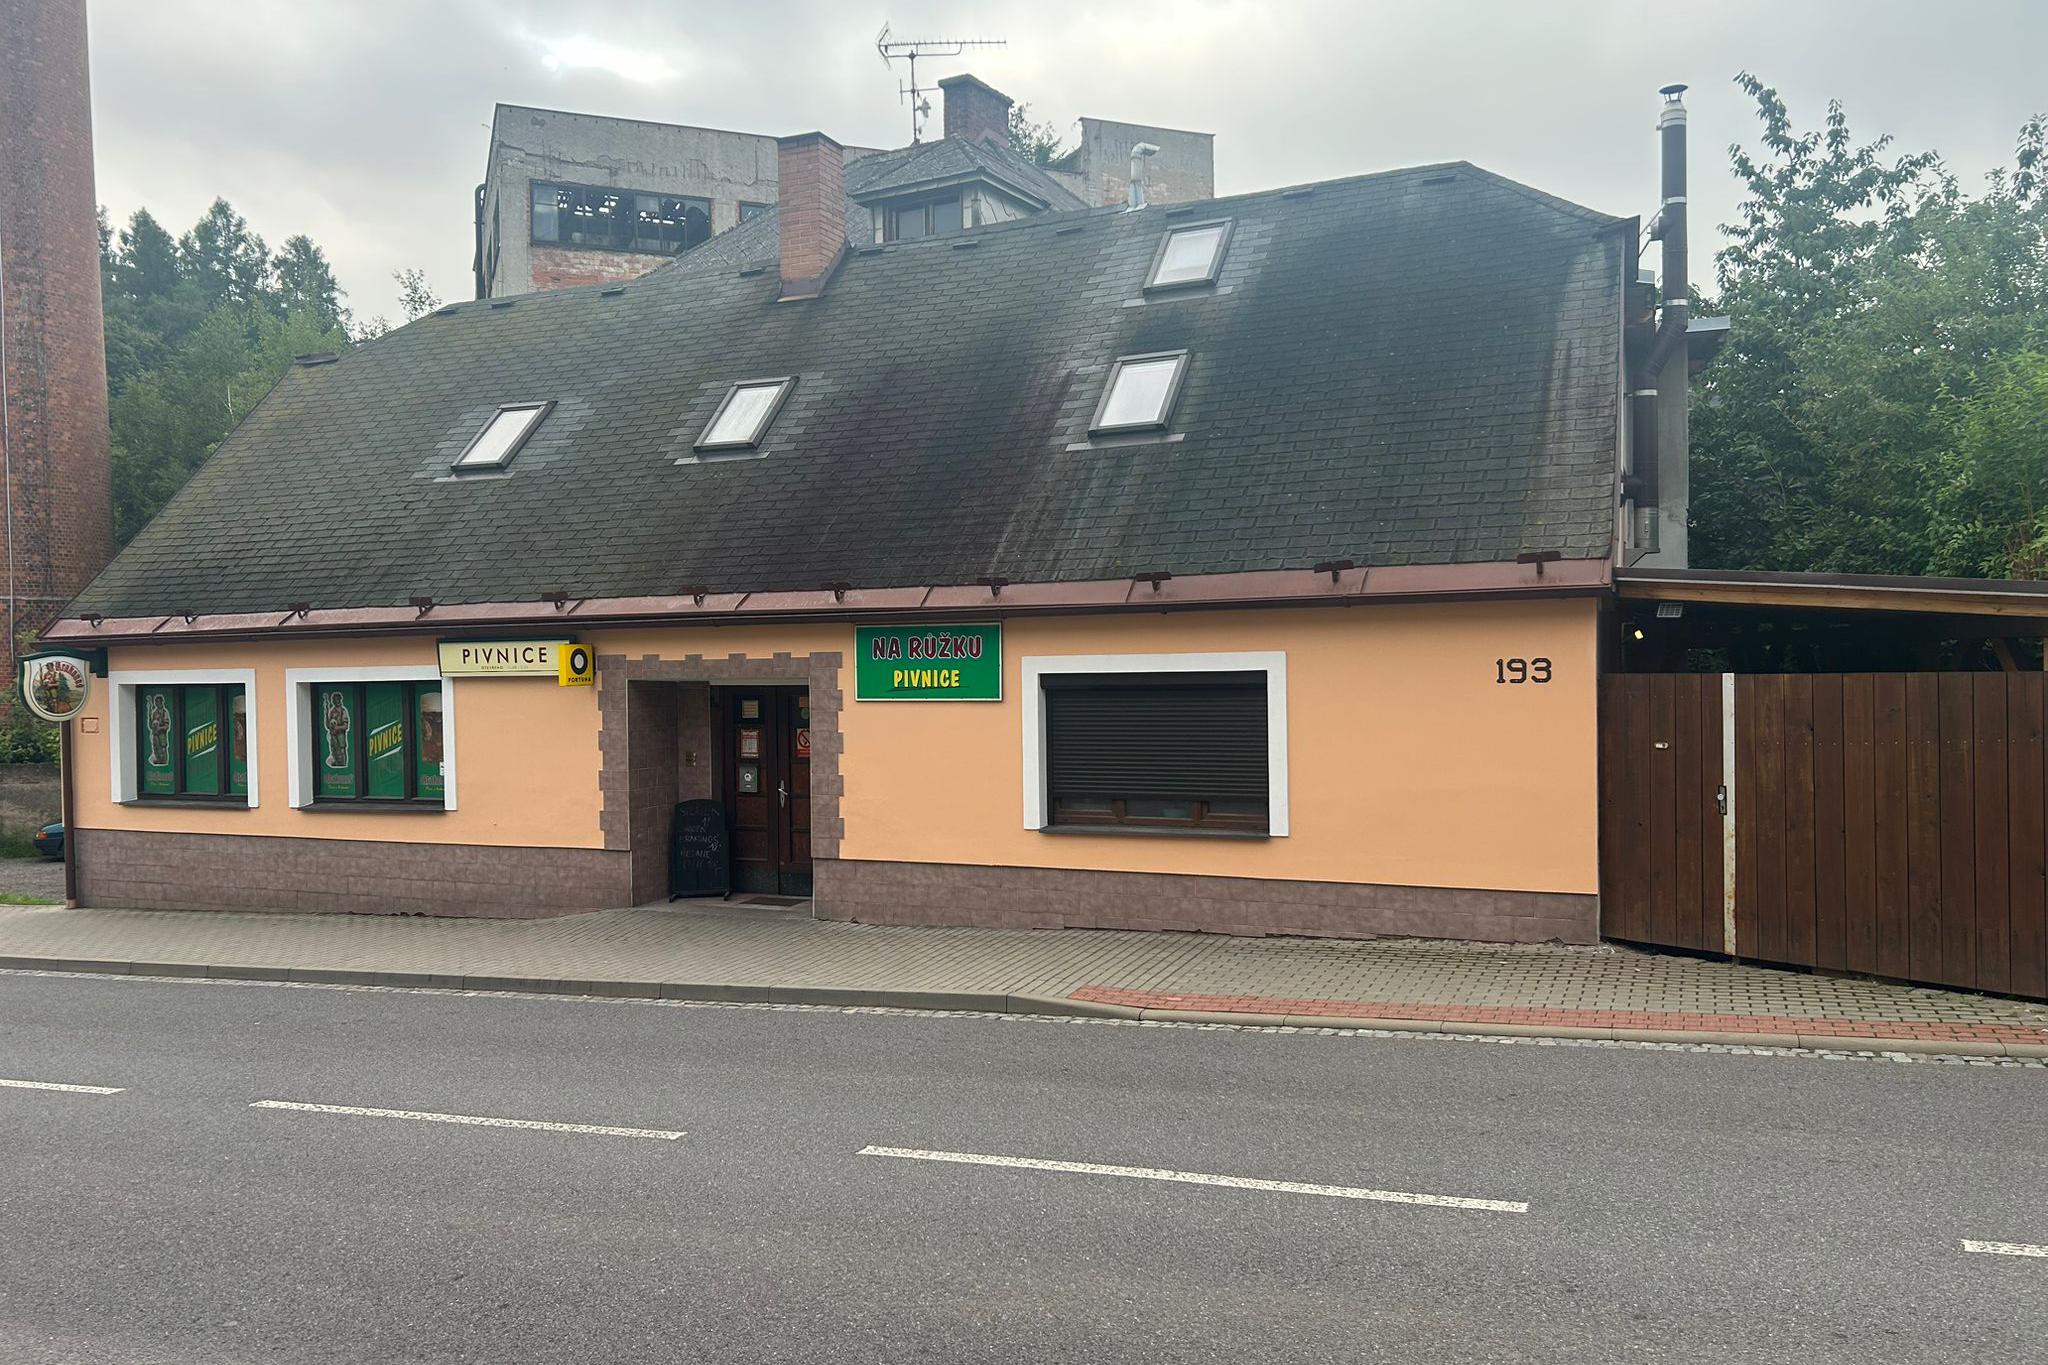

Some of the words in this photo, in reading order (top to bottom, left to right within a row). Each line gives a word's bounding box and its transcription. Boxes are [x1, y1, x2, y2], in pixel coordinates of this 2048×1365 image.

[462, 646, 548, 664] PIVNICE
[873, 637, 902, 660] NA
[908, 632, 983, 659] RŮŽKU
[893, 669, 961, 688] PIVNICE
[1496, 657, 1552, 683] 193
[187, 723, 217, 755] PIVNICE
[369, 723, 403, 757] PIVNICE
